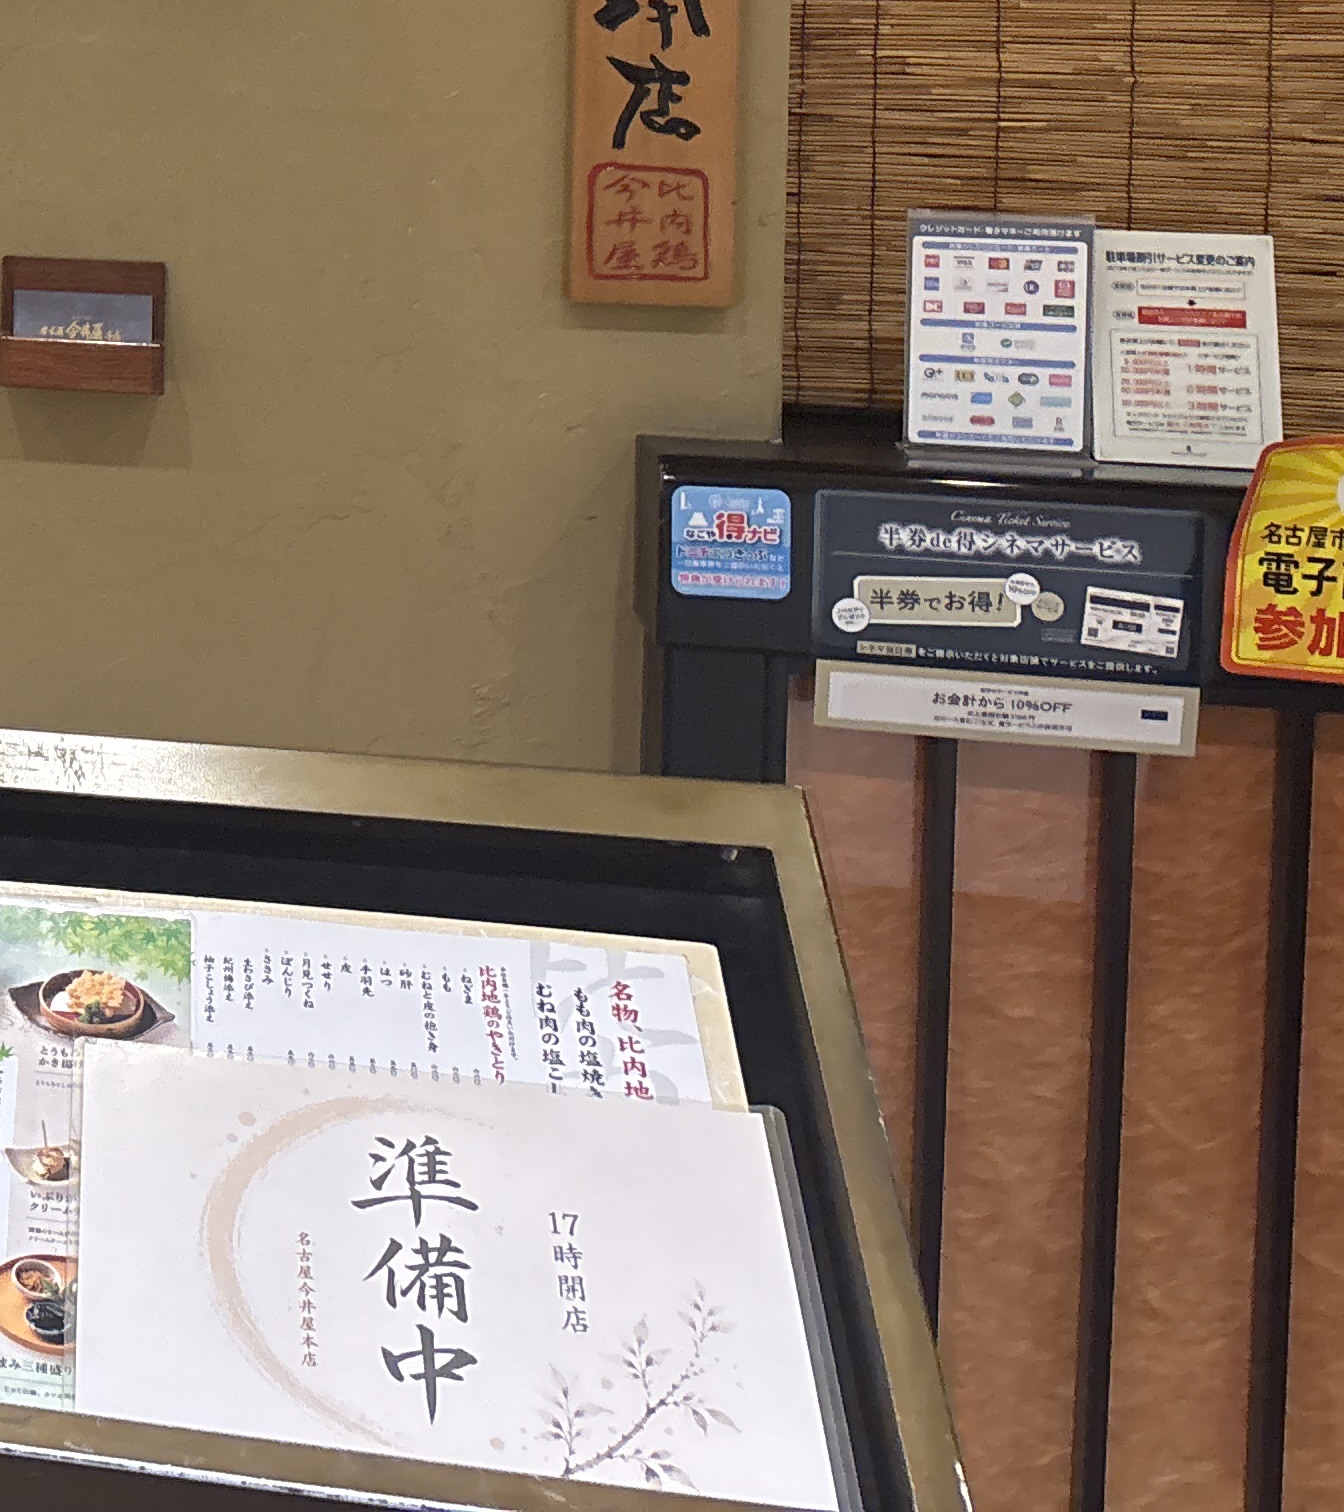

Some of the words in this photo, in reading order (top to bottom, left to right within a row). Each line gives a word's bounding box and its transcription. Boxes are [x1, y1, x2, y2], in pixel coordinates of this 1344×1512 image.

[602, 173, 653, 272] 今井屋
[684, 511, 780, 544] なごや得ナビ
[881, 524, 1140, 562] 半券de得シネマサービス
[478, 965, 505, 1086] 比内地鶏のやきとり
[608, 980, 654, 1101] 名物、比内地
[293, 1230, 319, 1368] 名古屋今井屋本店
[350, 1134, 480, 1426] 準備中
[548, 1211, 590, 1334] 17時開店
